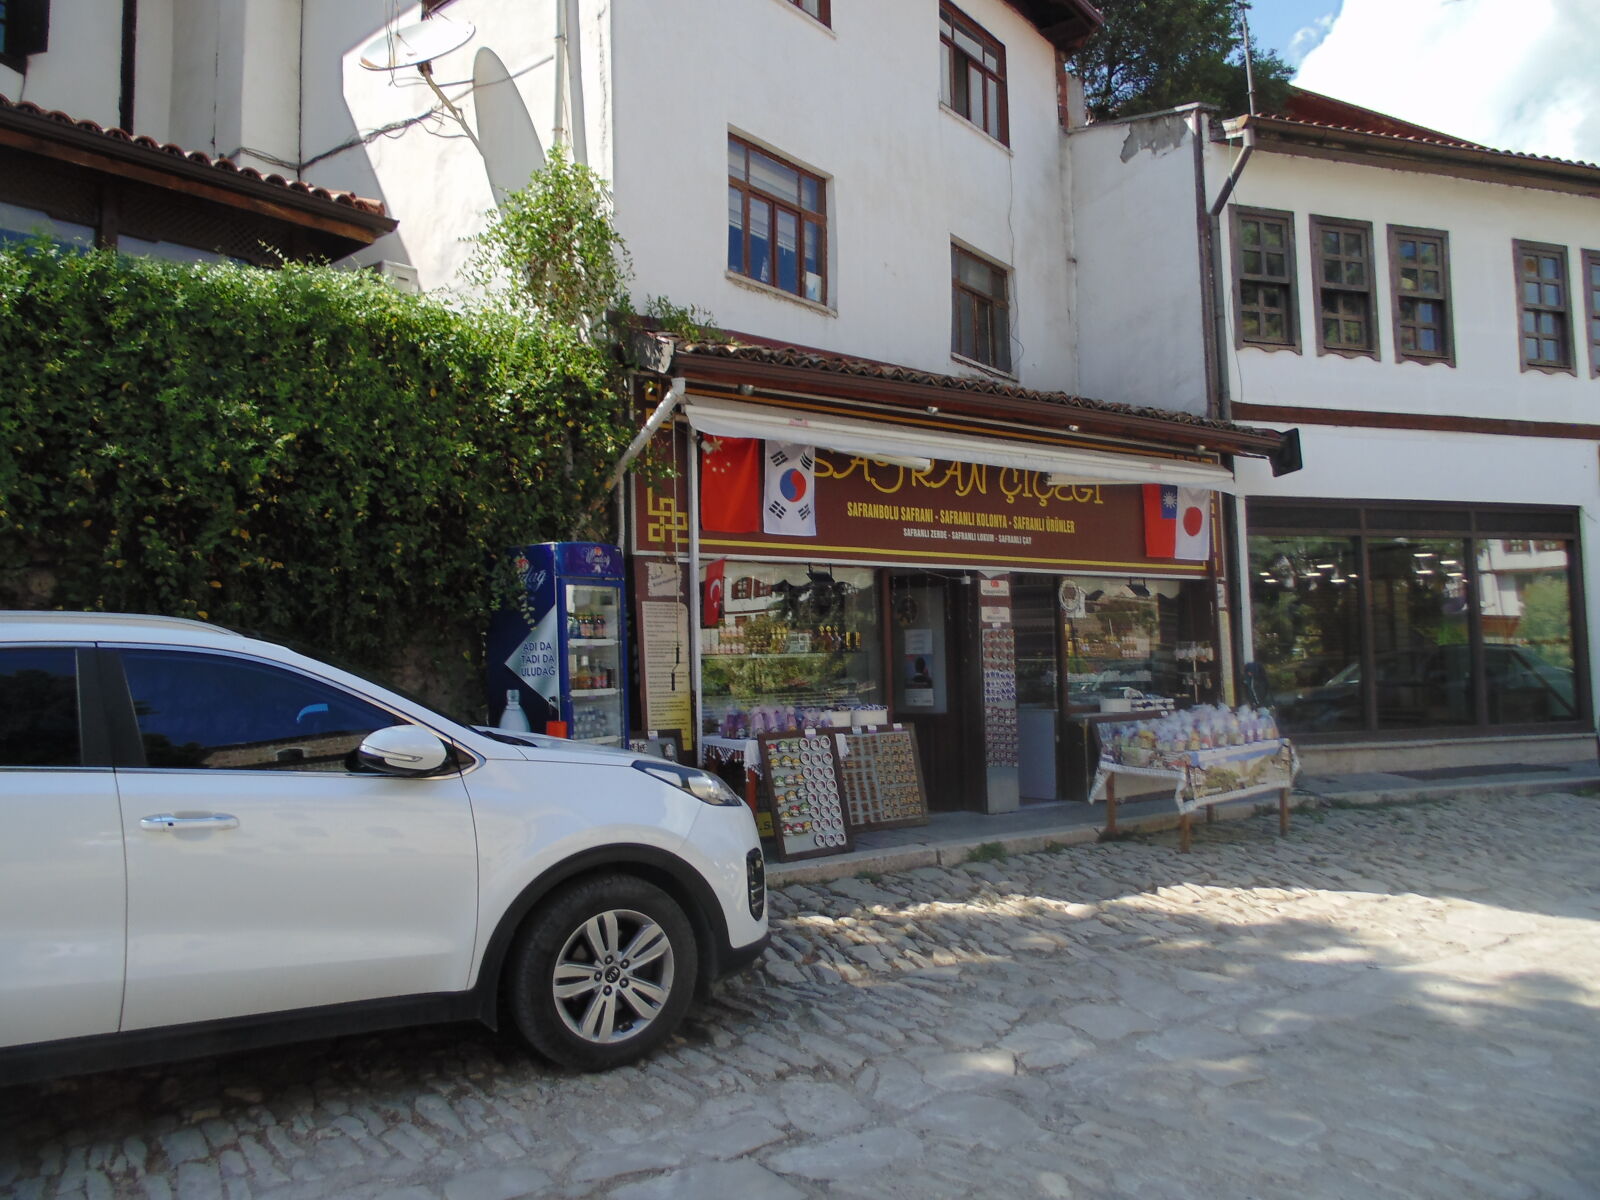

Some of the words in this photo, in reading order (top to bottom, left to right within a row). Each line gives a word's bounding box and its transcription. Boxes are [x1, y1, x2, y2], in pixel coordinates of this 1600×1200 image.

[847, 501, 899, 520] SAFRANBOLU
[940, 510, 975, 526] SAFRANLI
[976, 512, 1007, 528] KOLONYA
[1013, 515, 1045, 531] SAFRANLI
[1046, 516, 1075, 534] ÜRÜNLER
[903, 528, 930, 538] SAFRANLI
[951, 531, 977, 541] SAFRANLI
[998, 534, 1022, 544] SAFRANLI
[523, 642, 537, 651] ADI
[540, 641, 552, 651] DA
[521, 654, 540, 664] TADI
[542, 654, 555, 663] DA
